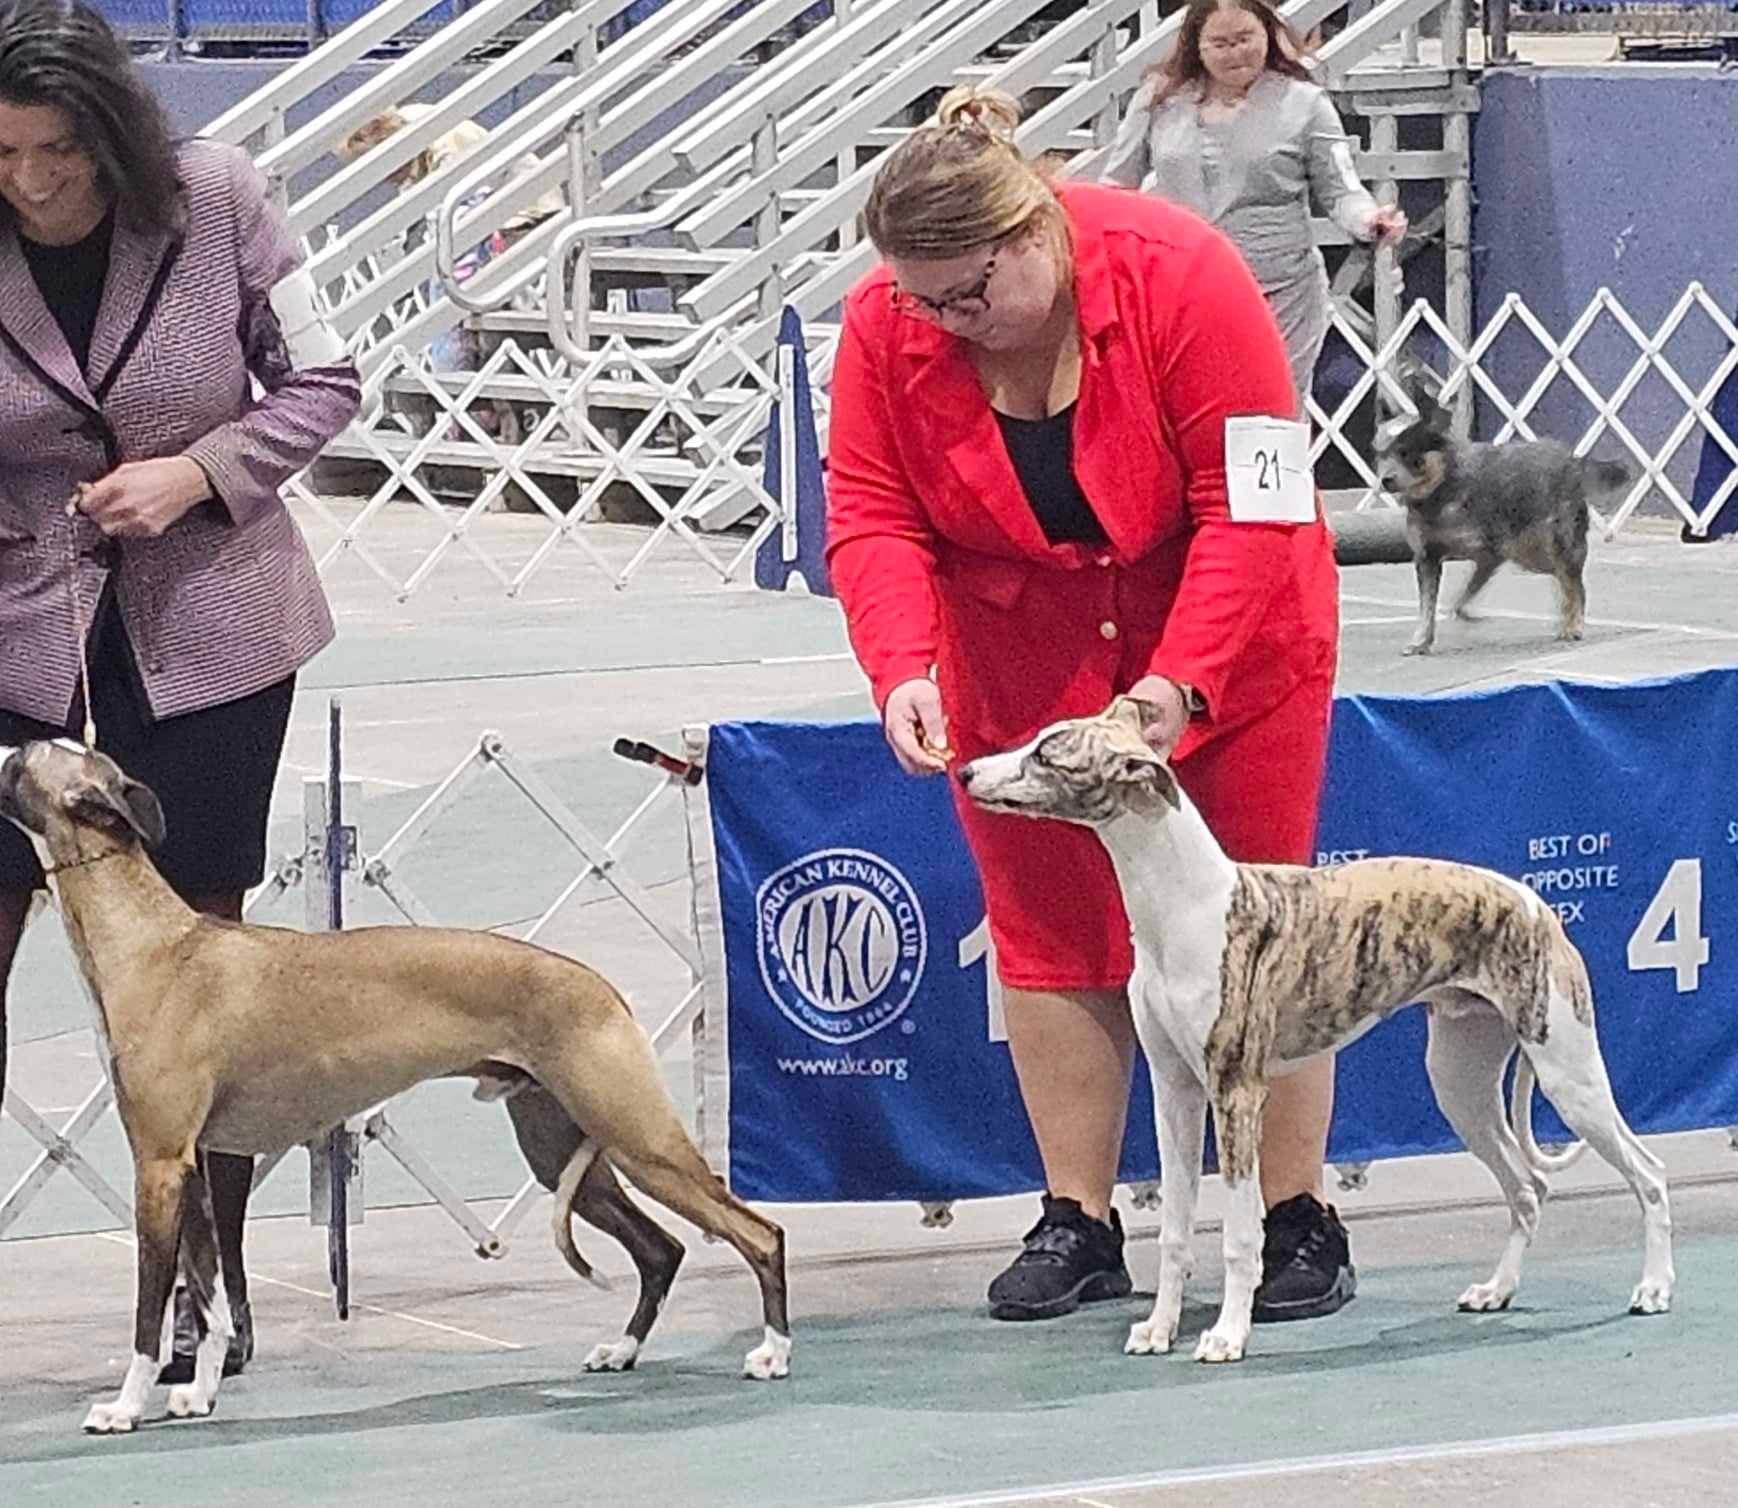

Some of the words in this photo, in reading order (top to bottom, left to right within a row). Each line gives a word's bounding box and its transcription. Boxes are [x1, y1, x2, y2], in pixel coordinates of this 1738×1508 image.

[1254, 449, 1281, 491] 21
[1521, 865, 1619, 892] OPPOSITE
[1527, 835, 1571, 860] BEST
[763, 863, 823, 961] AMERICAN
[827, 859, 900, 905] KENNEL
[1549, 900, 1585, 925] EX
[1627, 857, 1710, 993] 4
[790, 890, 889, 1006] AKC
[958, 911, 1008, 1042] 1
